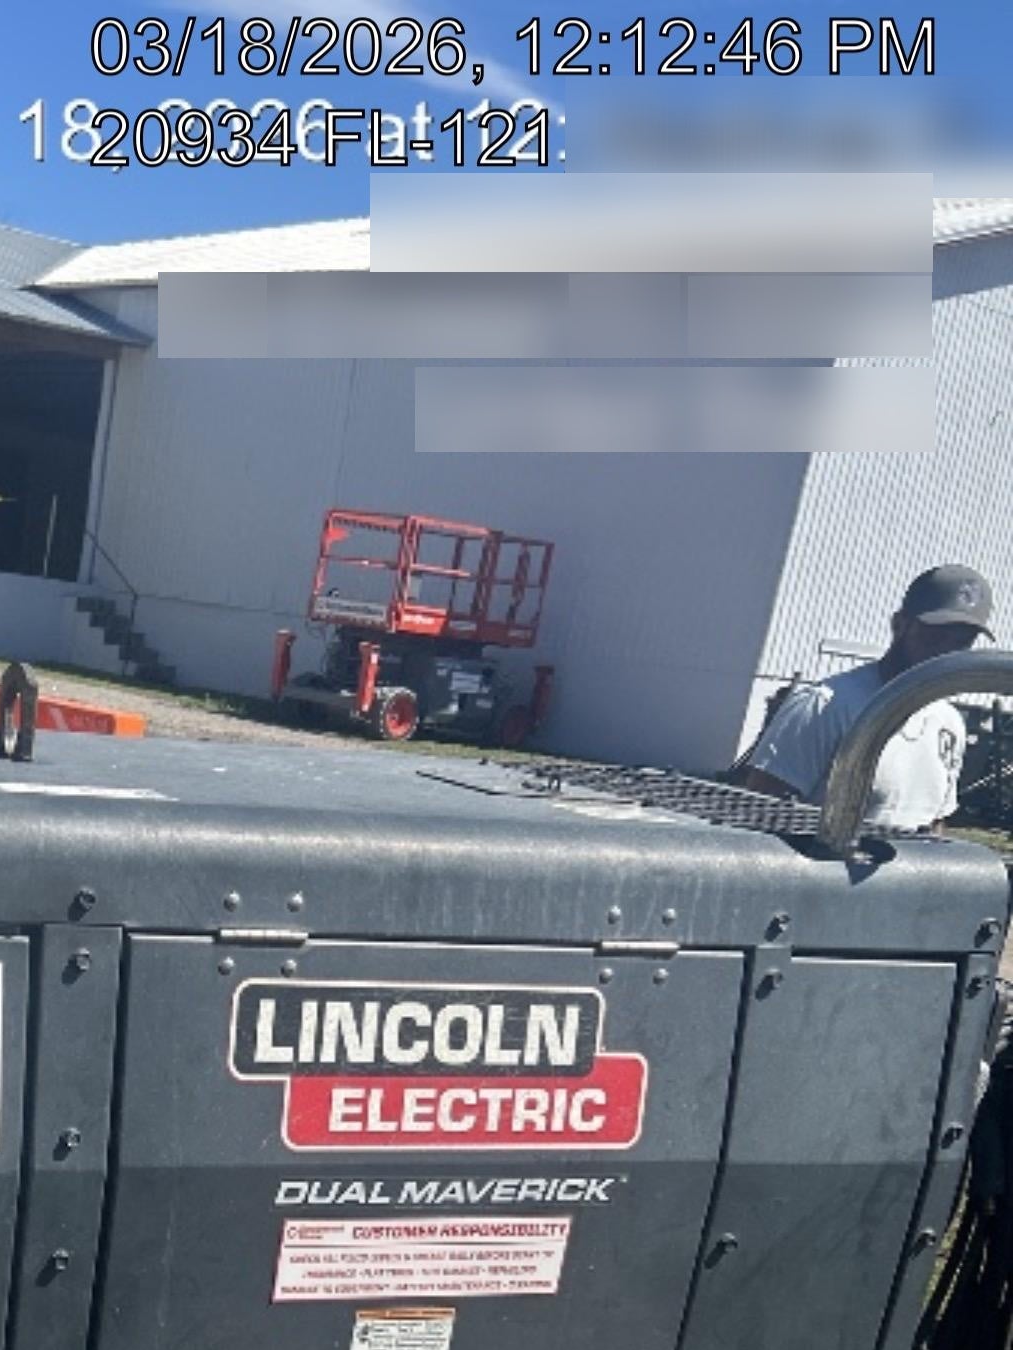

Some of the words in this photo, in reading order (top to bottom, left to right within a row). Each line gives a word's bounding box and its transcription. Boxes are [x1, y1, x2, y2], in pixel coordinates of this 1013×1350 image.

[253, 998, 582, 1067] LINCOLN
[327, 1086, 608, 1133] ELECTRIC
[275, 1181, 390, 1206] DUAL
[397, 1177, 616, 1204] MAVERICK
